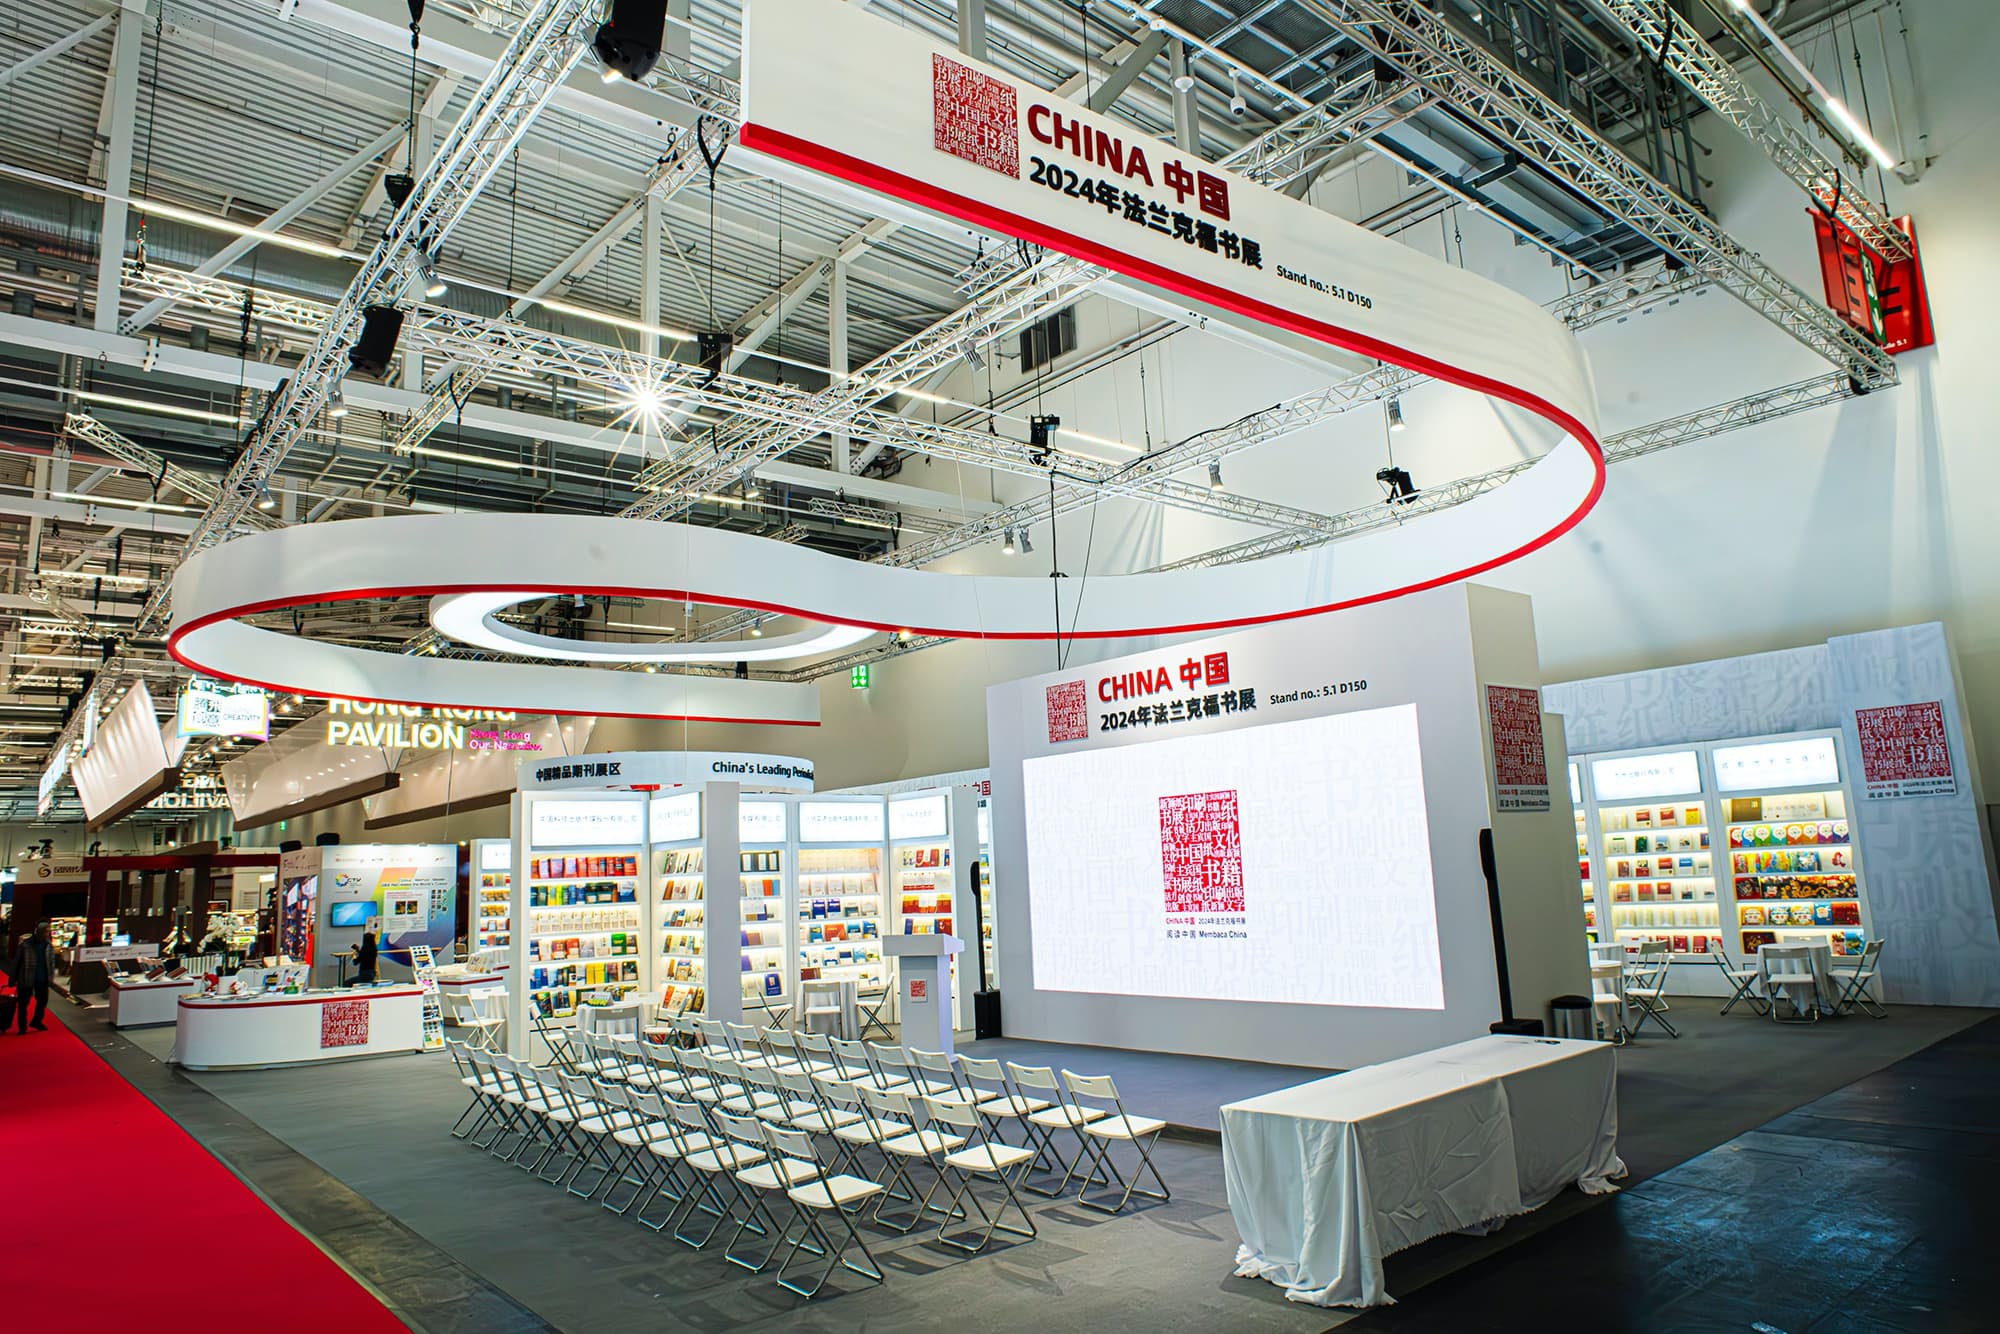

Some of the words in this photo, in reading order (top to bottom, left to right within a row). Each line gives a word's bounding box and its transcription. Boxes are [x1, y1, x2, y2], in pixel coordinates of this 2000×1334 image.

[950, 99, 980, 126] 中国
[979, 125, 1018, 159] 书籍
[1027, 104, 1154, 187] CHINA
[1163, 160, 1230, 221] 中国
[1030, 156, 1263, 270] 2024年法兰克福书展
[1277, 265, 1307, 285] Stand
[1309, 279, 1329, 294] no.:
[1331, 285, 1345, 300] 5.1
[1347, 291, 1372, 309] D150
[1098, 667, 1173, 703] CHINA
[1179, 651, 1230, 690] 中国
[1270, 690, 1298, 705] Stand
[1300, 687, 1321, 700] no.:
[1323, 685, 1337, 697] 5.1
[1340, 679, 1367, 695] D150
[1100, 687, 1257, 732] 2024年法兰克福书展
[327, 721, 464, 750] PAVILION
[469, 739, 491, 751] Our
[1905, 744, 1946, 764] 书籍
[535, 762, 621, 783] 中国精品期刊展区
[712, 761, 754, 773] China's
[757, 763, 791, 778] Leading
[1183, 794, 1205, 812] 印刷
[1221, 800, 1238, 822] 纸
[1160, 808, 1183, 827] 书展
[1213, 829, 1240, 850] 文化
[1175, 842, 1204, 865] 中国
[1201, 857, 1242, 888] 书籍
[1199, 930, 1228, 938] Membaca
[1229, 930, 1247, 938] China
